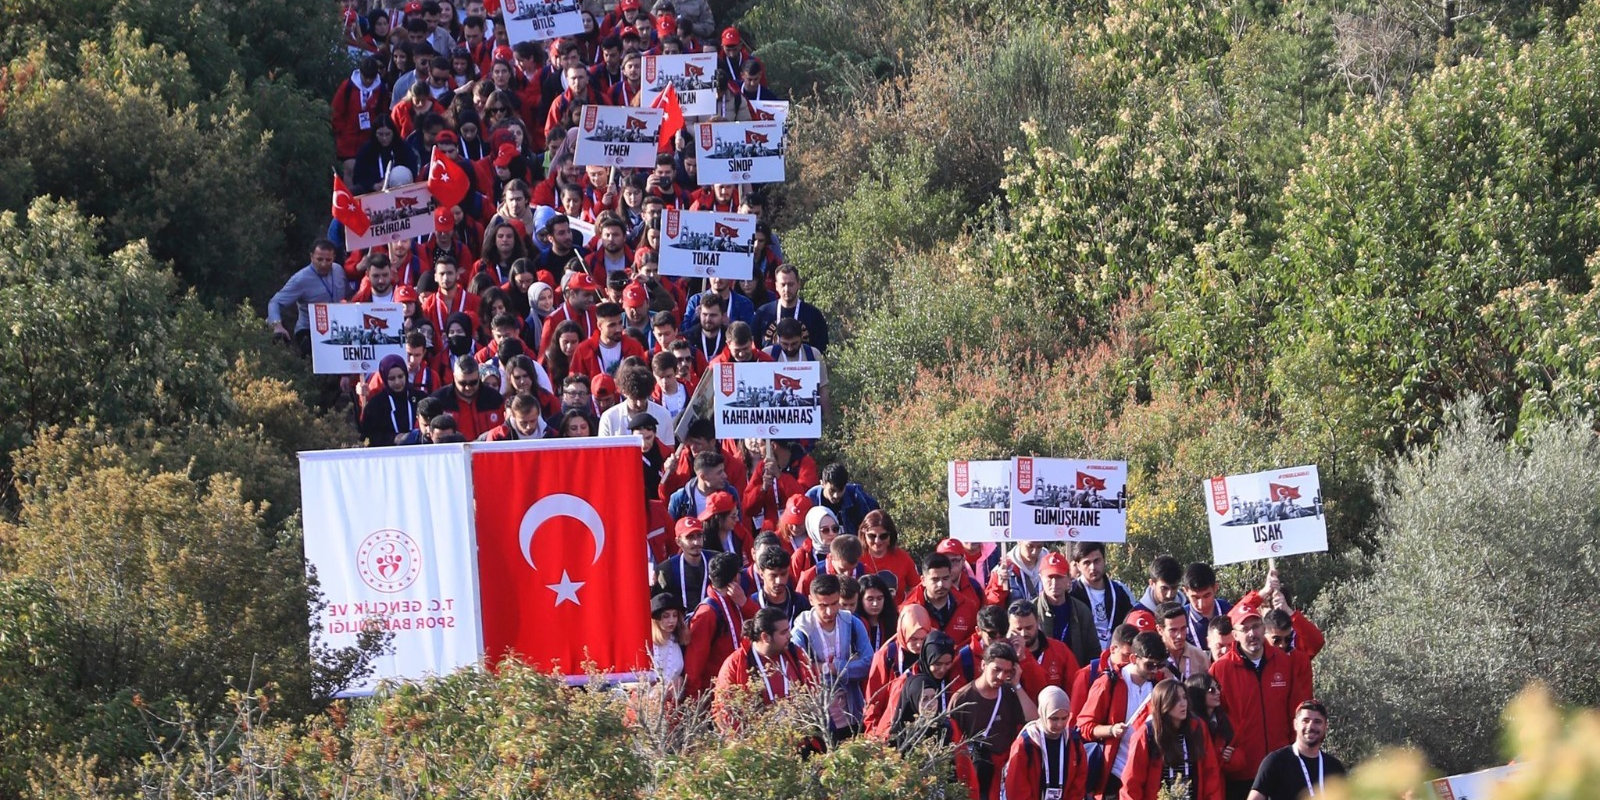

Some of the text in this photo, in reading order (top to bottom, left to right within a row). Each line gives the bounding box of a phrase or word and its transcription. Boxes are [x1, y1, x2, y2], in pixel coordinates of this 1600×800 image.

[532, 16, 555, 31] BİTLİS
[677, 92, 696, 104] NCAN
[603, 144, 630, 156] YEMEN
[728, 158, 753, 172] SİNOP
[370, 218, 411, 237] TEKİRDAĞ
[692, 252, 721, 266] TOKAT
[343, 345, 375, 361] DENİZLİ
[722, 409, 813, 425] KAHRAMANMARAŞ
[989, 511, 1010, 527] ORD
[1034, 507, 1101, 527] GÜMÜŞHANE
[1252, 523, 1283, 543] UŞAK
